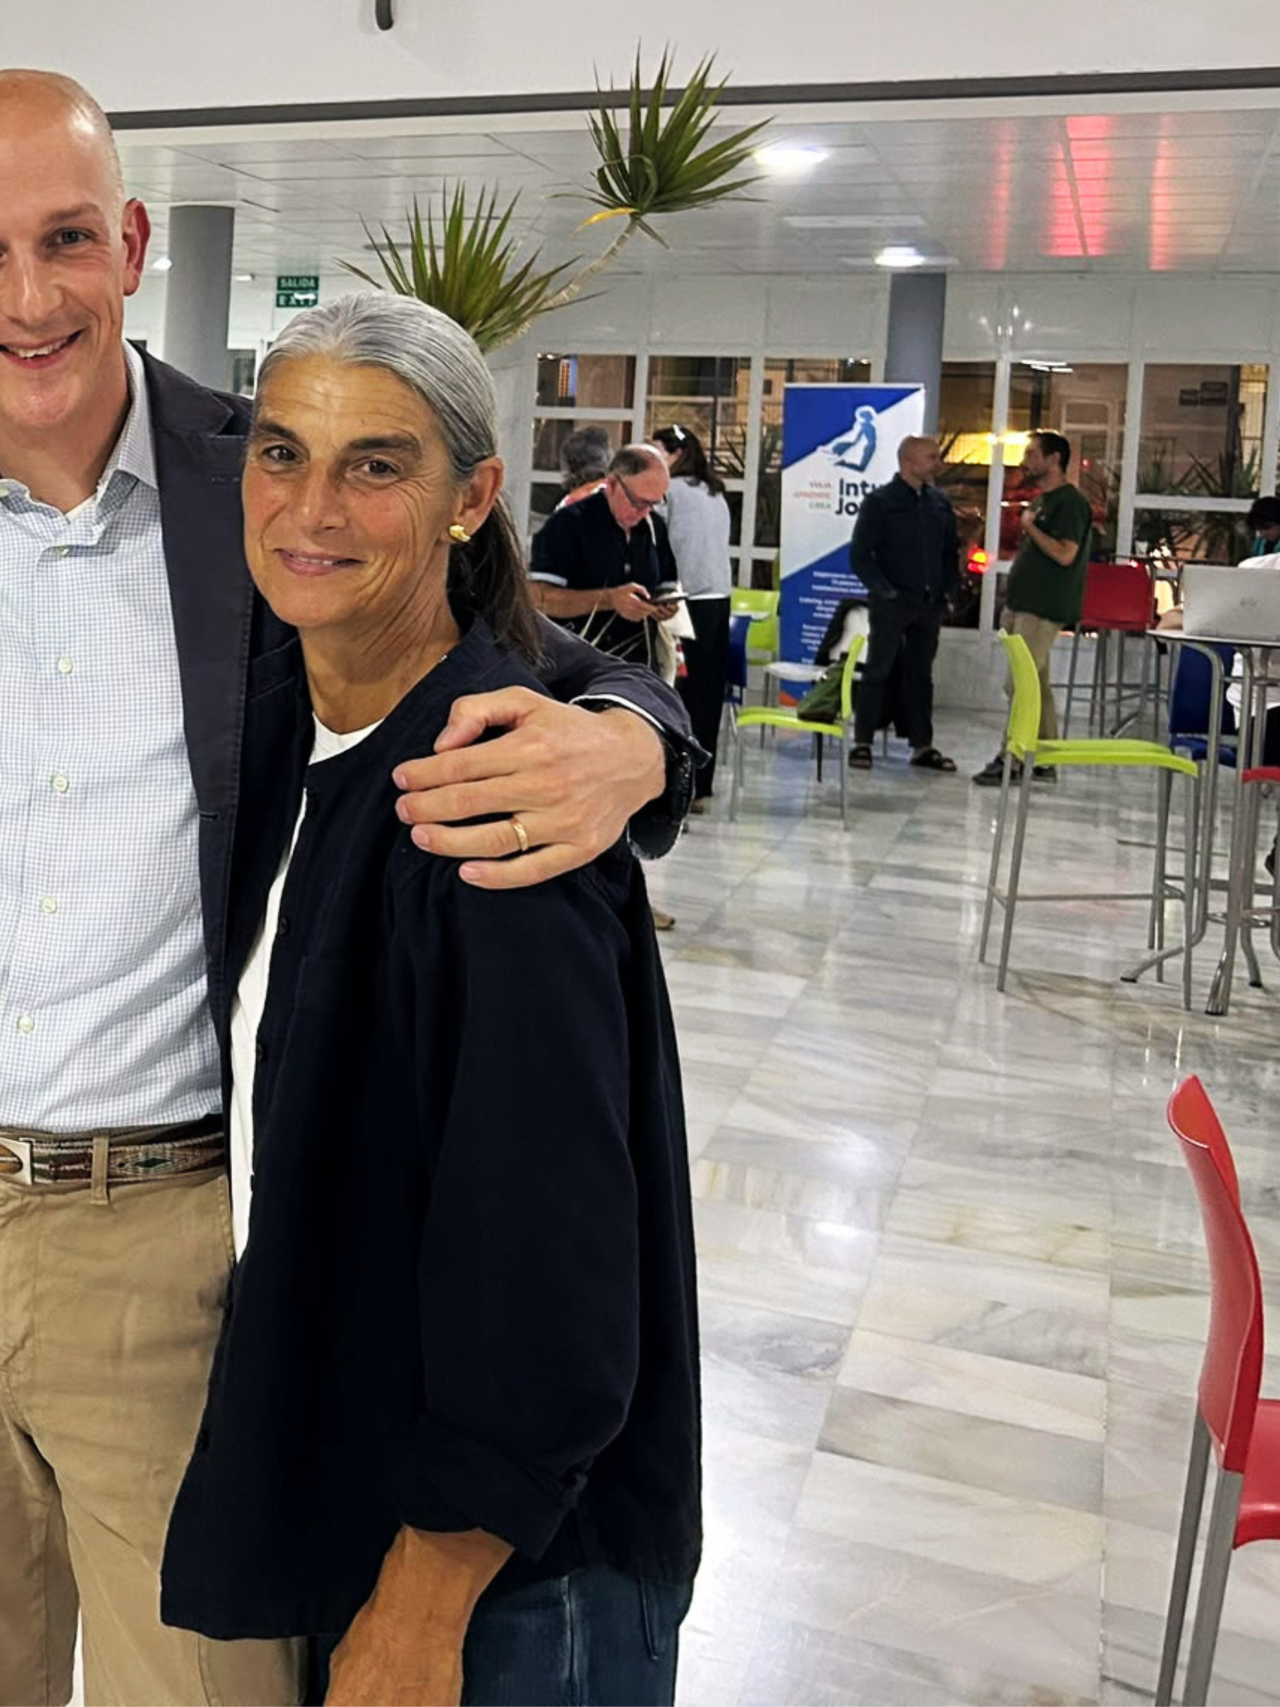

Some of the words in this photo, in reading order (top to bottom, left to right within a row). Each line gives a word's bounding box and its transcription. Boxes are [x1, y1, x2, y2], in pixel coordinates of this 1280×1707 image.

[280, 278, 315, 288] SALIDA
[839, 478, 876, 497] Int
[809, 501, 832, 509] CREA
